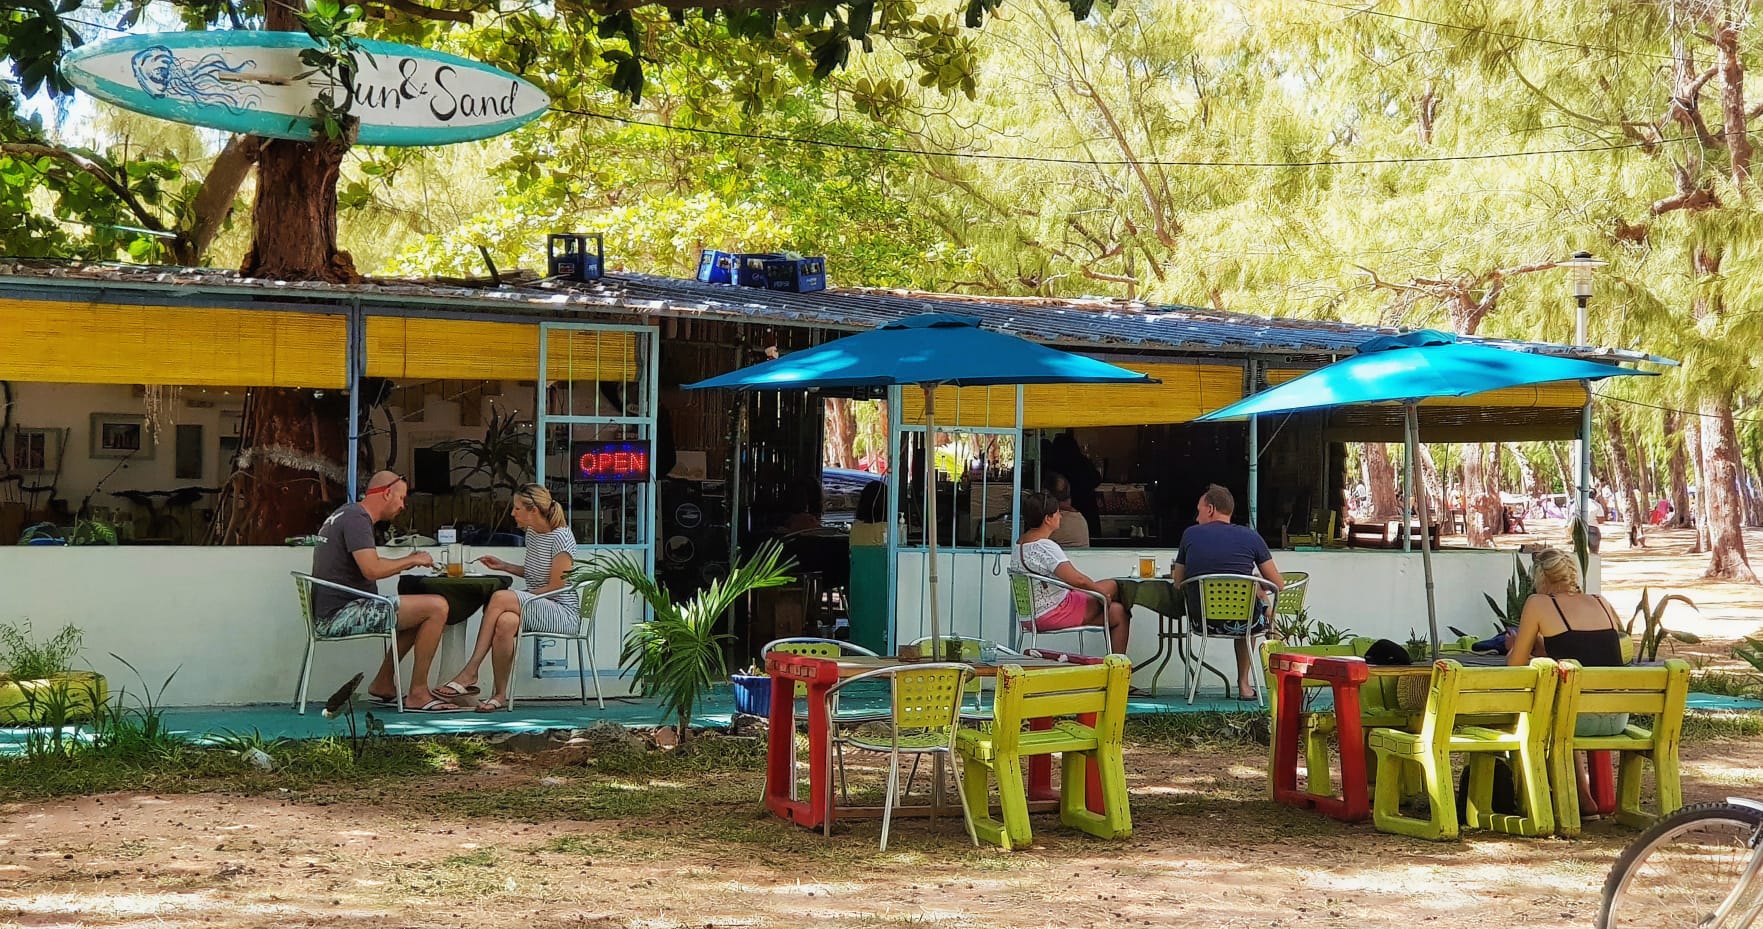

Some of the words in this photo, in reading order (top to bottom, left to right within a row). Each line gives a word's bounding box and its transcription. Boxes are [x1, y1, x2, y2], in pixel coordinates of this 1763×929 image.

[399, 58, 428, 100] &
[430, 65, 518, 122] Sand
[579, 452, 646, 474] OPEN
